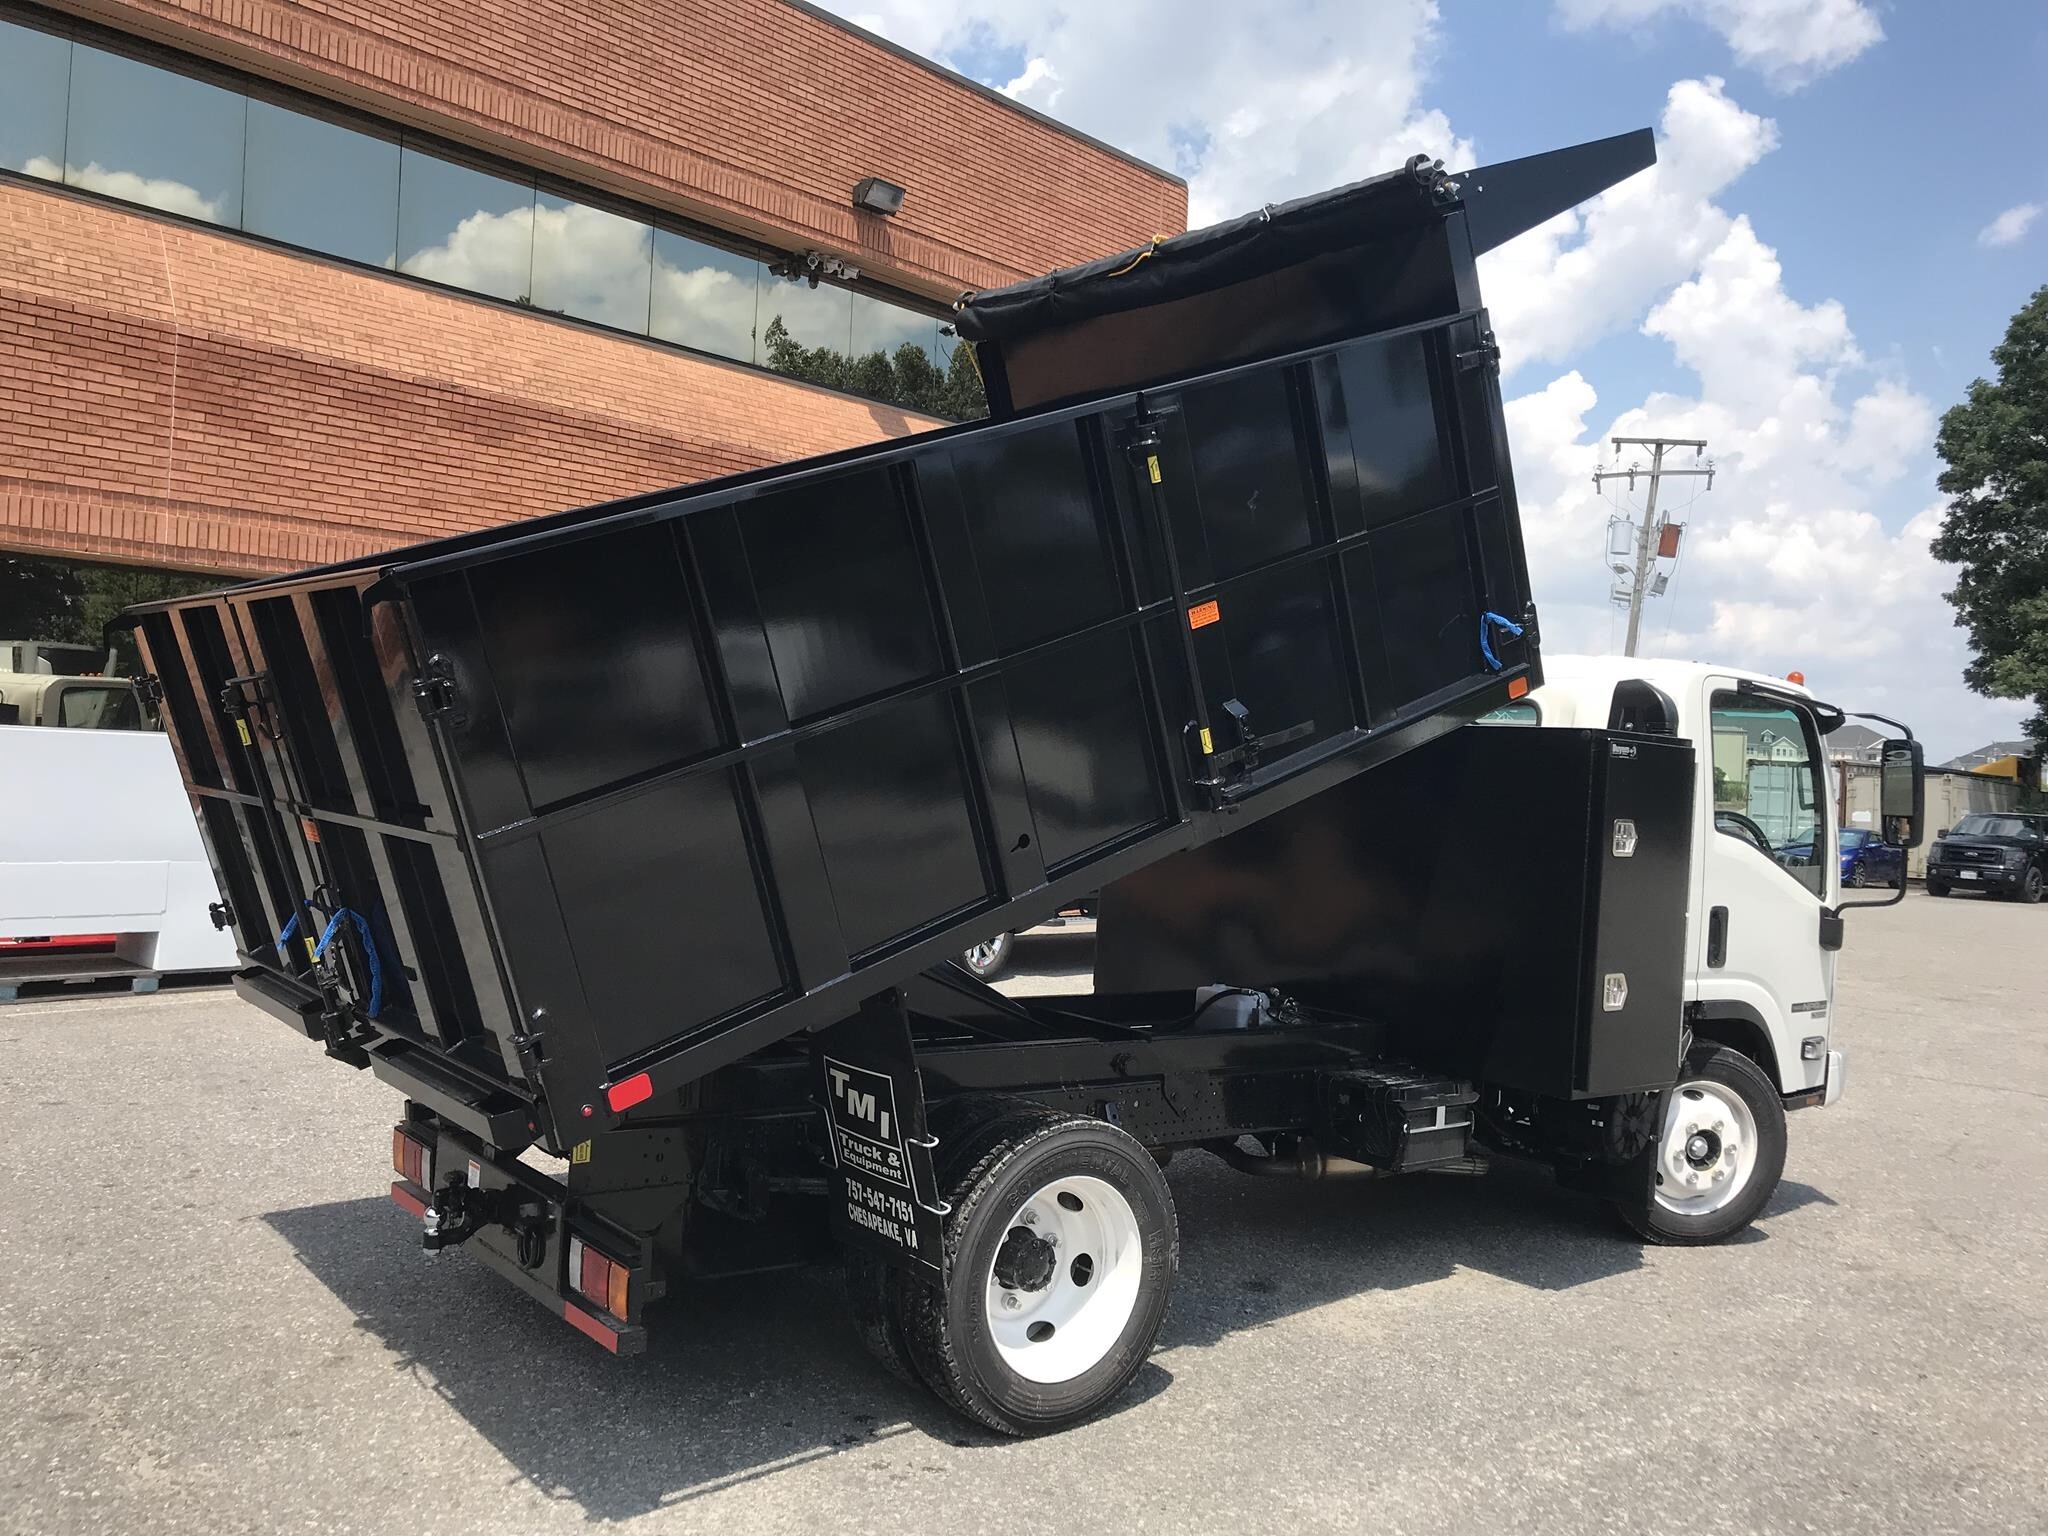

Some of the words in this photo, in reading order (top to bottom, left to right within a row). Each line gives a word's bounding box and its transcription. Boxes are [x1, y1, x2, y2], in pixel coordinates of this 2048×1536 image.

[829, 1067, 890, 1140] TMI
[839, 1132, 883, 1161] Truck
[887, 1151, 901, 1168] &
[843, 1149, 902, 1180] Equipment
[845, 1177, 915, 1224] 757-547-7151
[904, 1229, 919, 1250] VA
